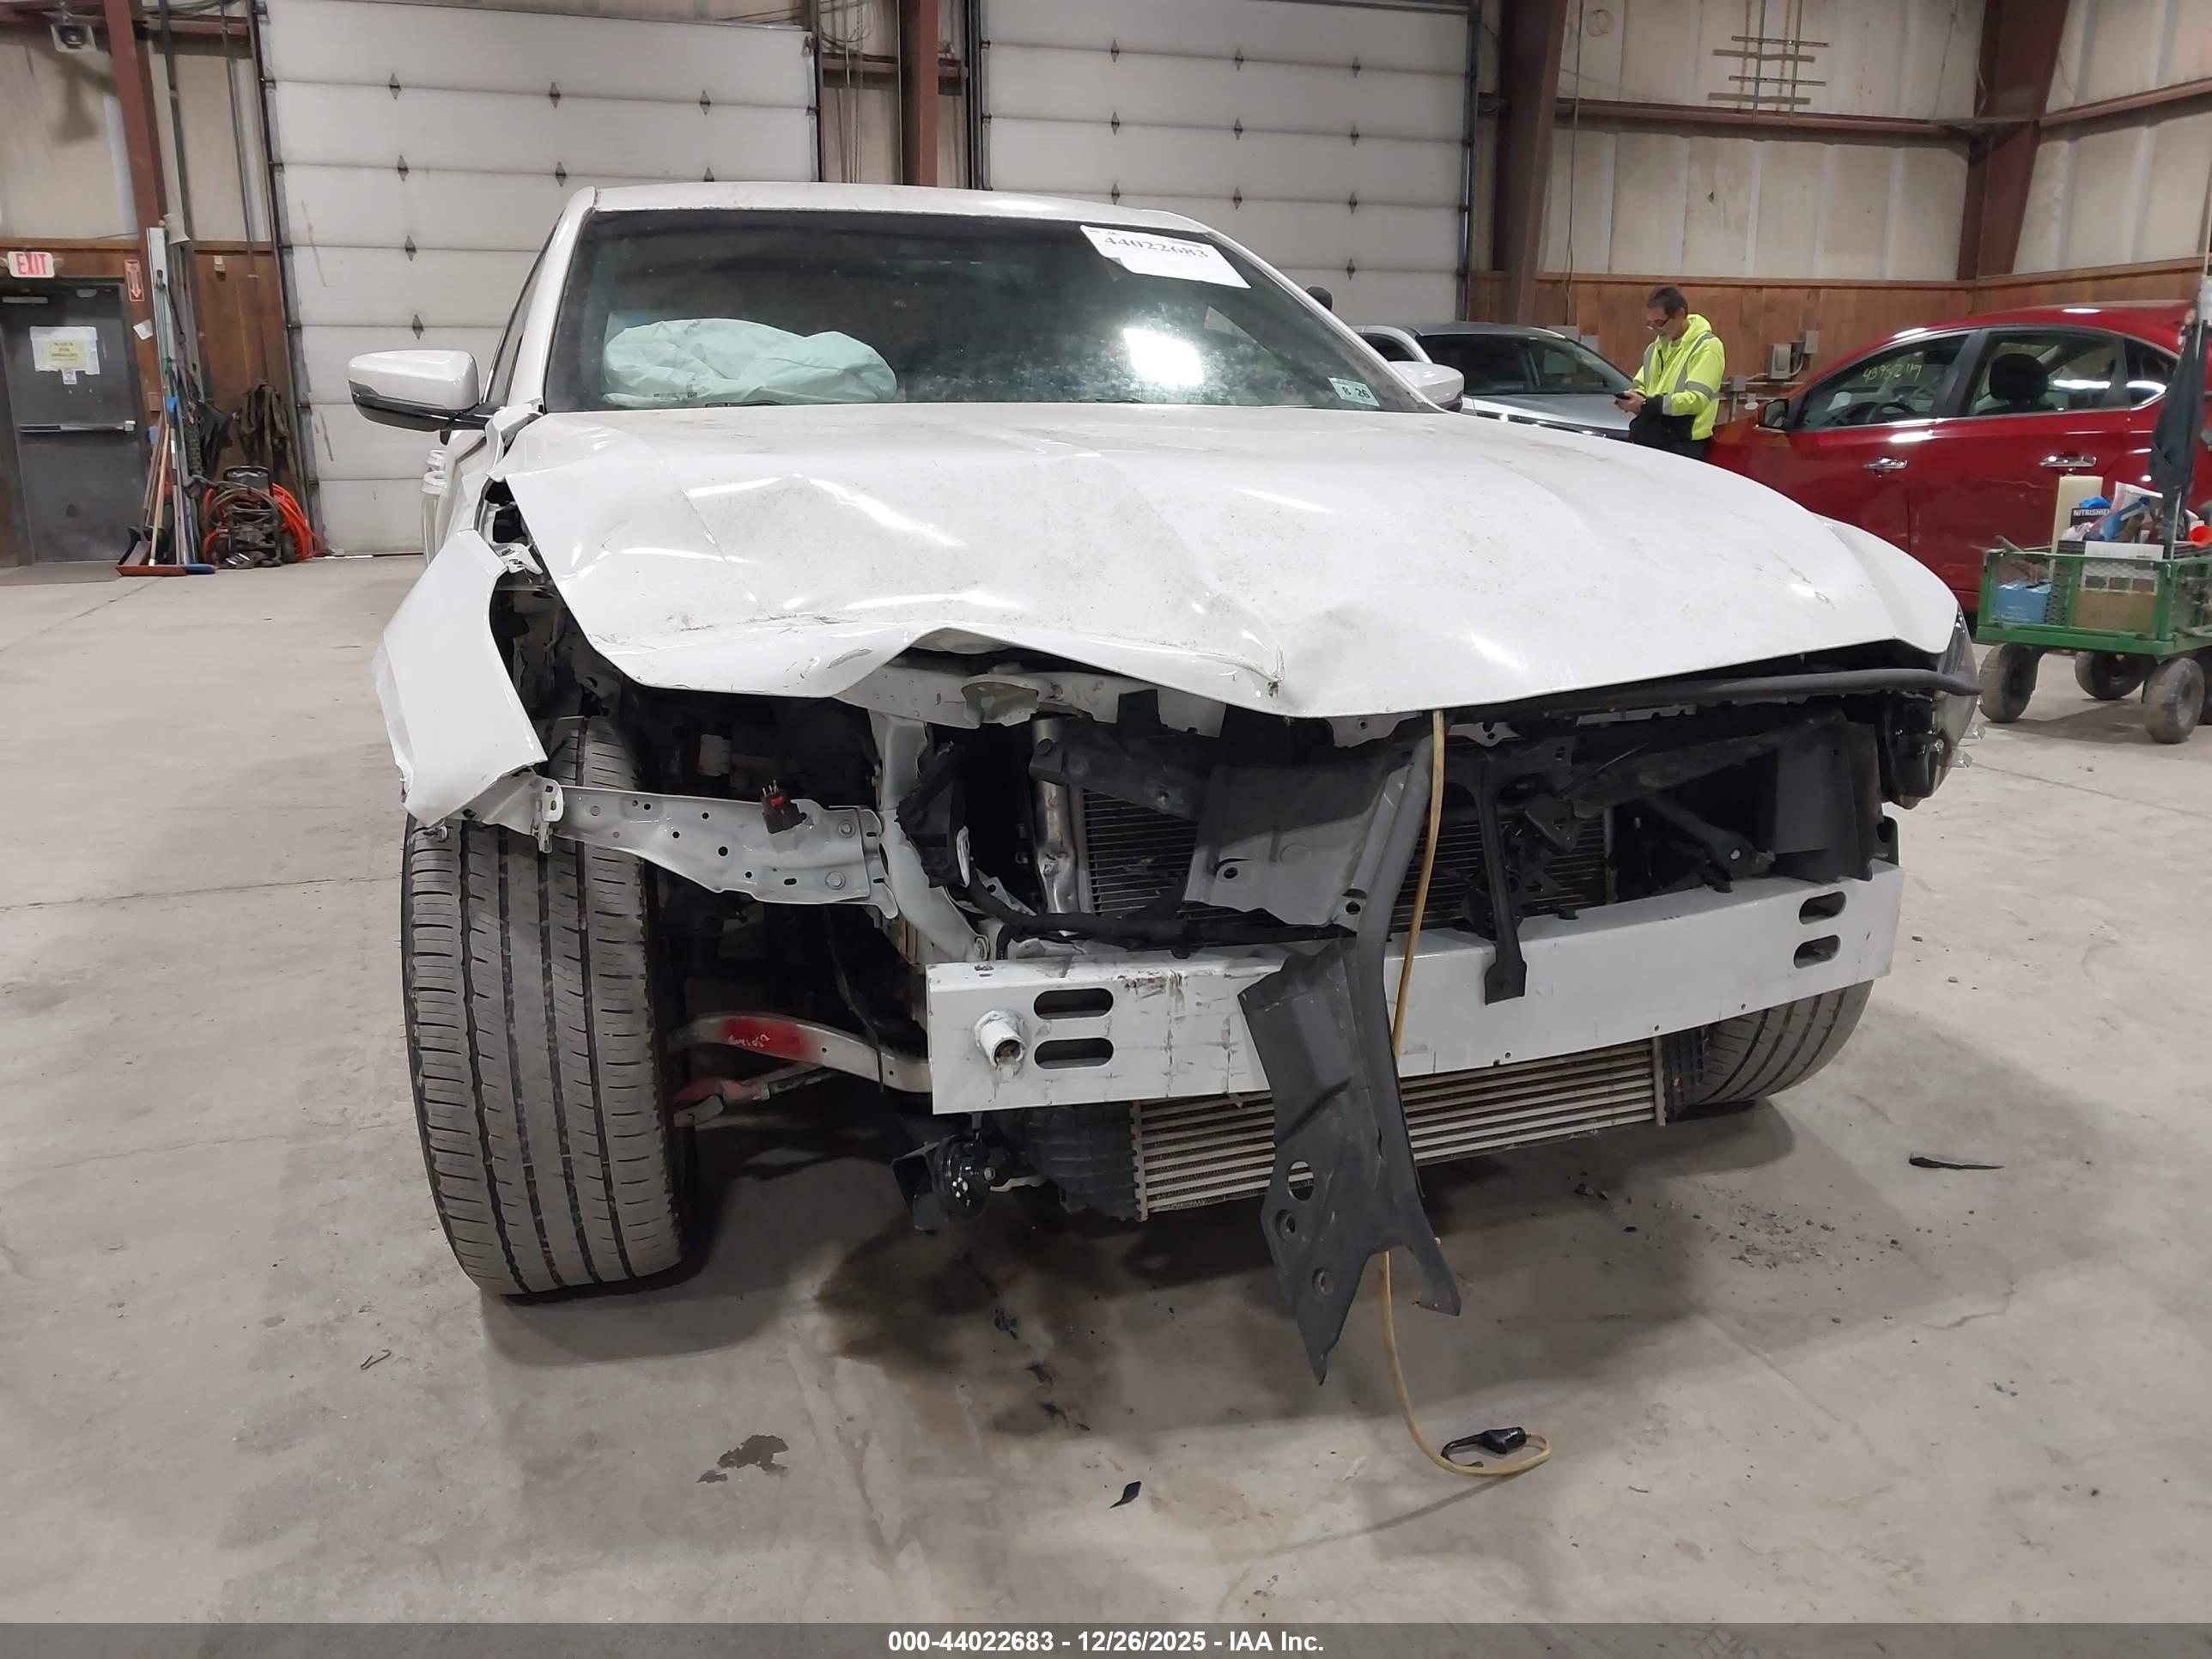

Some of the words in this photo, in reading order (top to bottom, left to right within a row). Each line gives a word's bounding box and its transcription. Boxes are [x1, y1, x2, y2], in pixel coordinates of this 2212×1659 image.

[1104, 236, 1208, 258] 44022683
[15, 252, 46, 275] EXIT
[1354, 387, 1371, 399] 26
